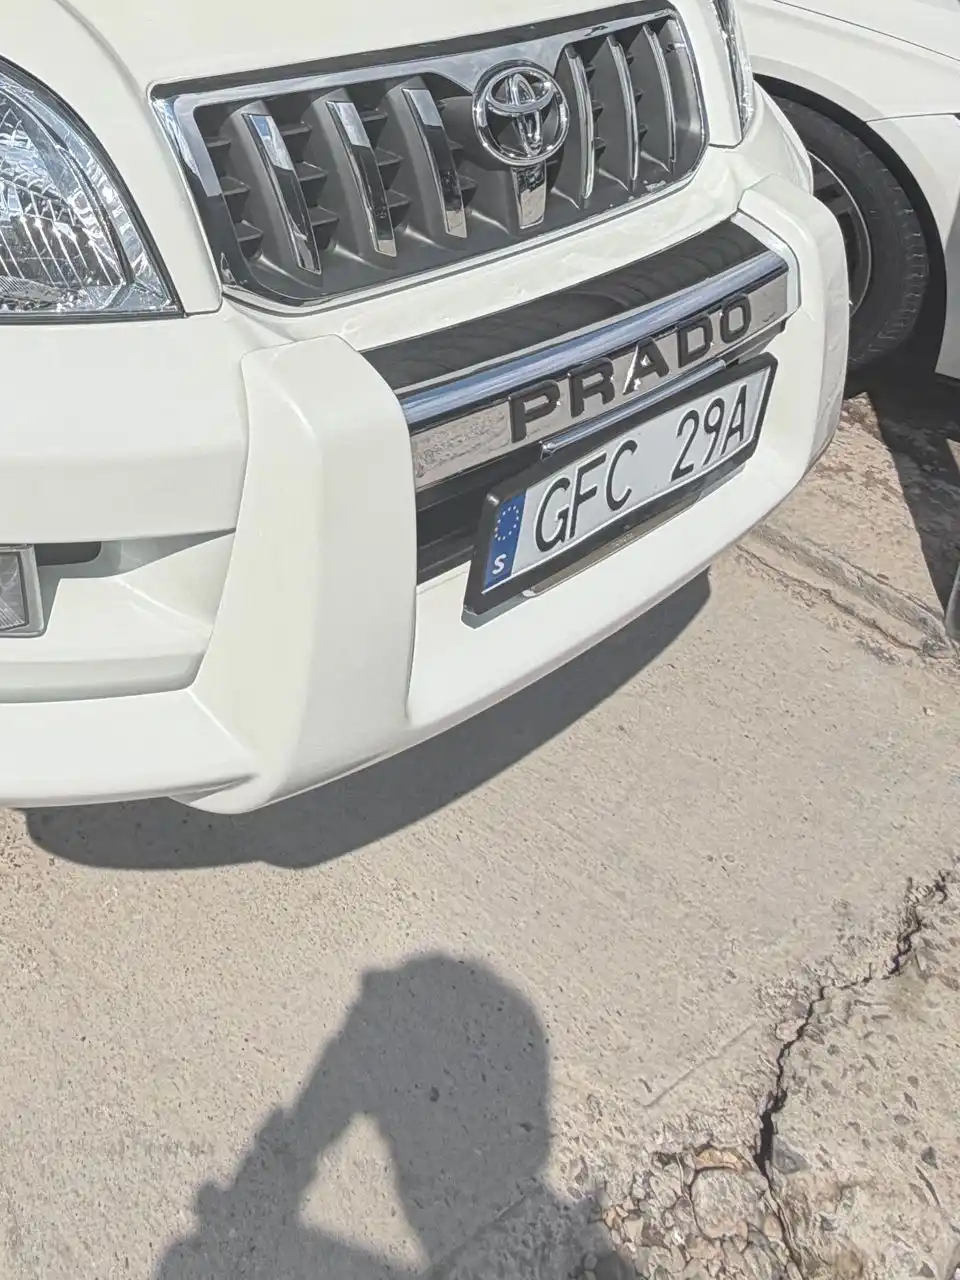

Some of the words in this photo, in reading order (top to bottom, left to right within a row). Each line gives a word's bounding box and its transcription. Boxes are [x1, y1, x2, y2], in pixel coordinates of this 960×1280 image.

[508, 291, 752, 443] PRADO
[535, 439, 638, 553] GFC
[671, 384, 748, 483] 29A
[492, 553, 507, 575] S
